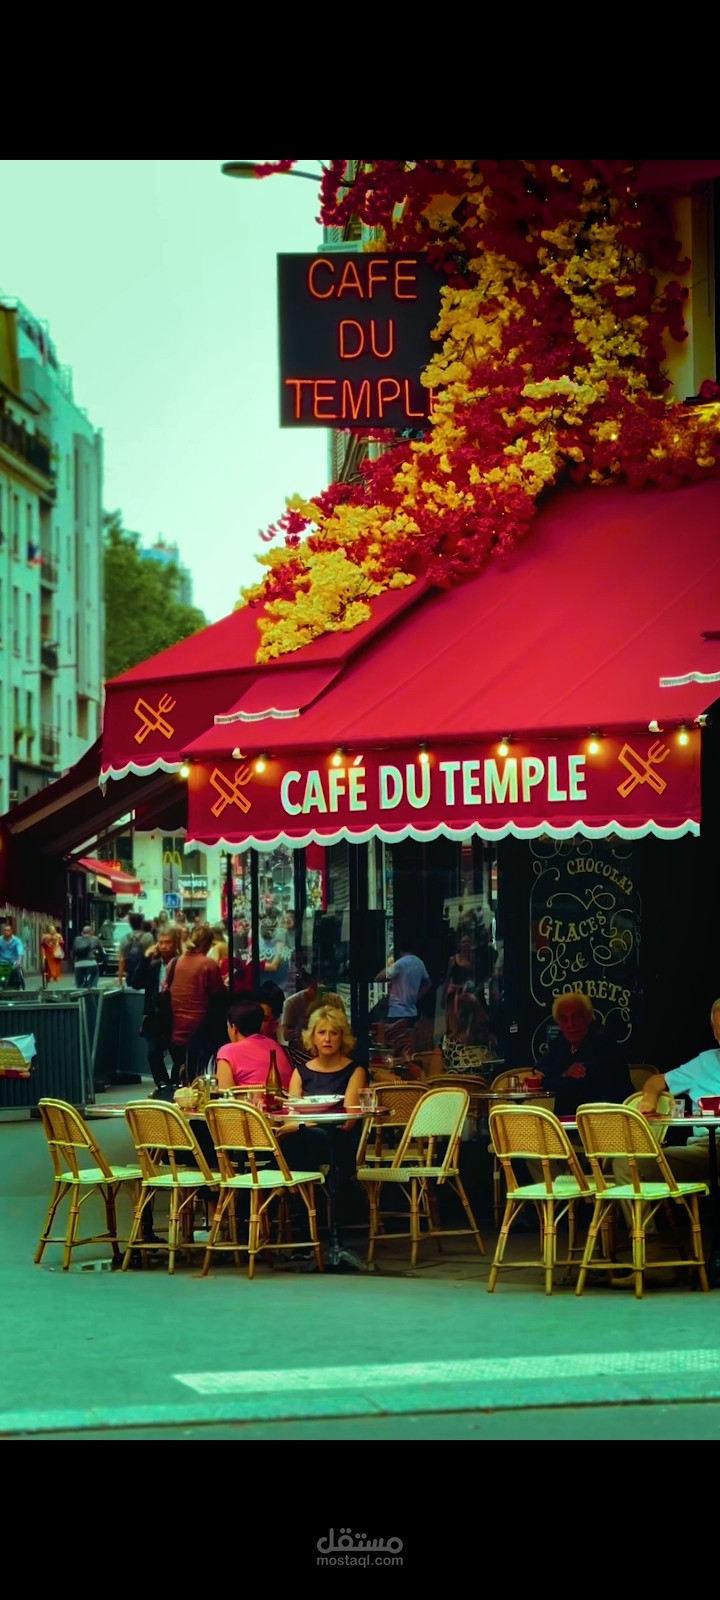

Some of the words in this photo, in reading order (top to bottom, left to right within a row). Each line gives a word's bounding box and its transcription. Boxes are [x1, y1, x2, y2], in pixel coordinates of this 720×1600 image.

[307, 258, 418, 299] CAFE
[339, 319, 394, 359] DU
[280, 756, 367, 815] CAFÉ
[378, 762, 431, 810] DU
[439, 754, 588, 807] TEMPLE
[538, 910, 607, 943] GLACES
[570, 952, 588, 972] &
